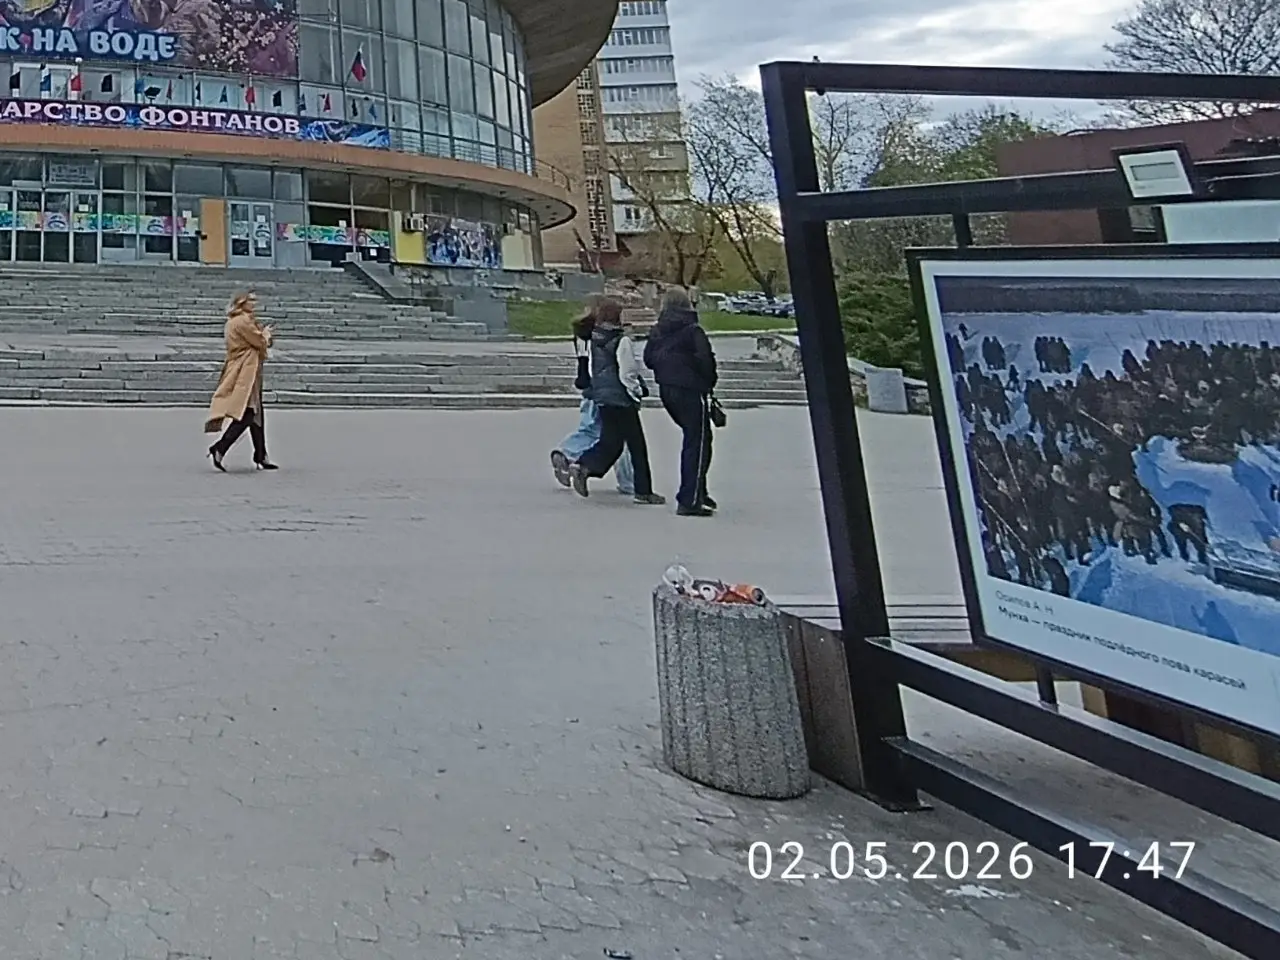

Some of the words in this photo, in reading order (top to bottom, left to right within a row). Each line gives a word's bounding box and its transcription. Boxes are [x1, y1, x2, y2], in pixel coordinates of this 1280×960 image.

[31, 28, 78, 53] НА
[89, 31, 176, 61] ВОДЕ
[140, 106, 300, 134] ФОНТАНОВ
[1043, 620, 1092, 642] праздник
